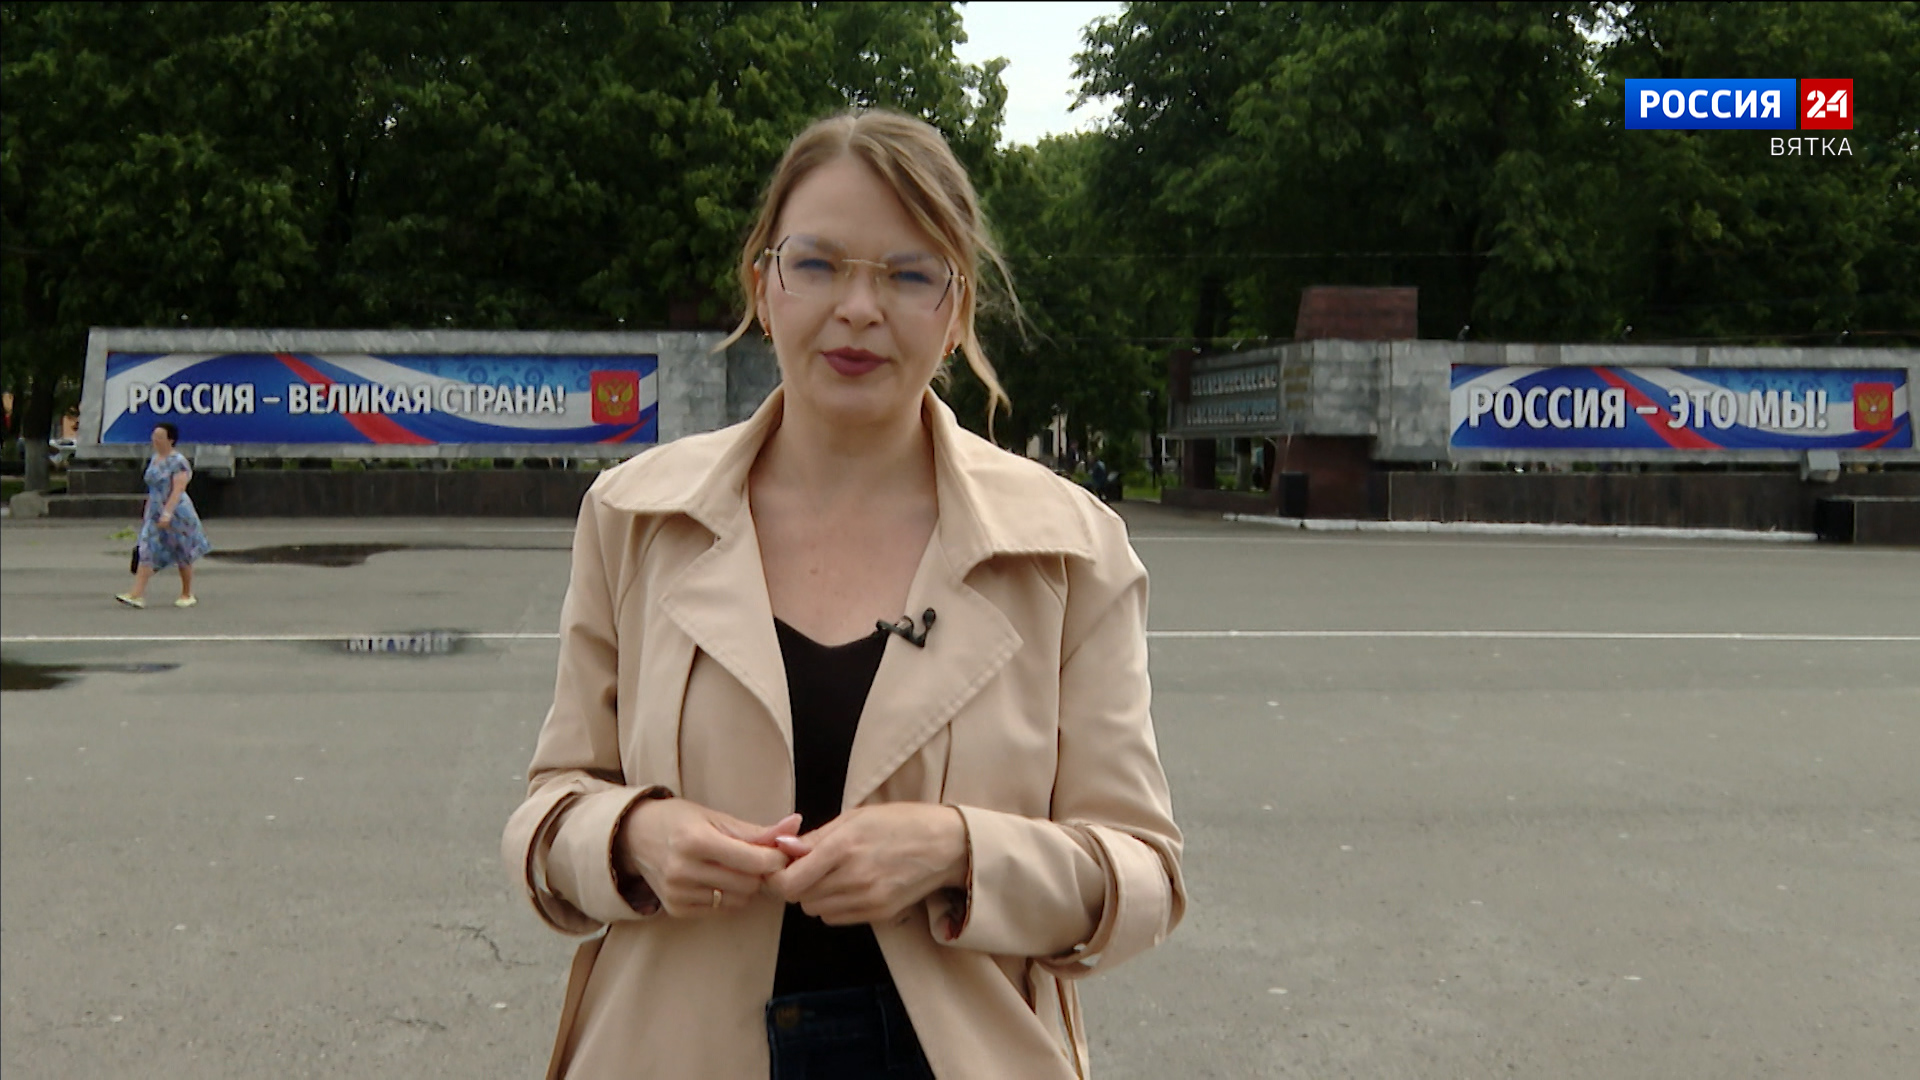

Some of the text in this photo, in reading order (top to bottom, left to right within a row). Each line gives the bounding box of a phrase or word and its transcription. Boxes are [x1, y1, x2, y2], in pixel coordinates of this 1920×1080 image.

[128, 383, 255, 414] РОССИЯ
[288, 383, 432, 414] ВЕЛИКАЯ
[440, 383, 565, 414] СТРАНА!
[1468, 386, 1626, 429] РОССИЯ
[1667, 387, 1738, 429] ЭТО
[1748, 388, 1828, 429] МЫ!
